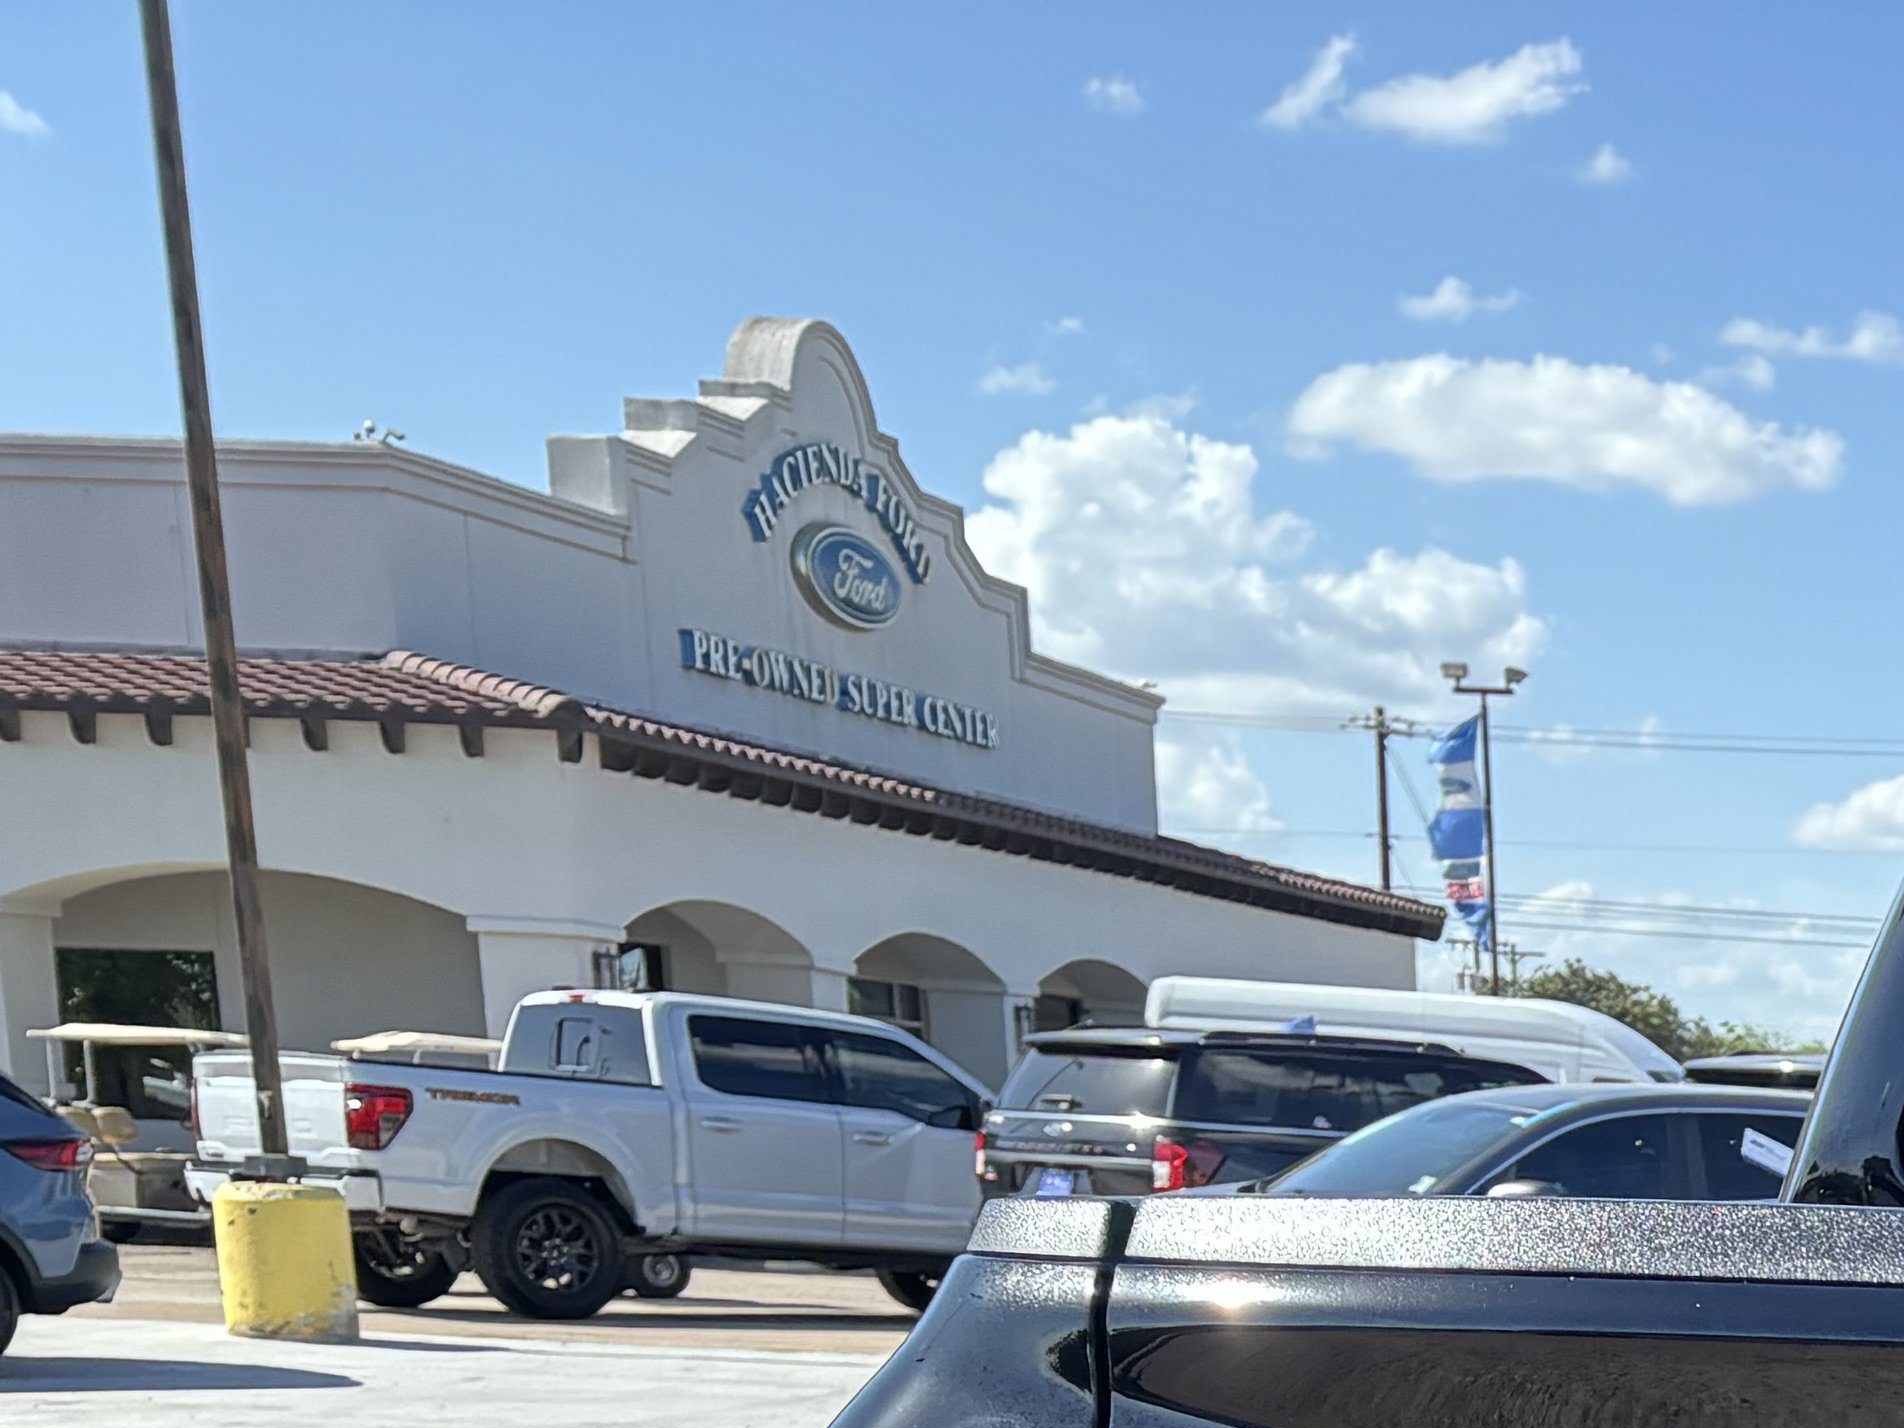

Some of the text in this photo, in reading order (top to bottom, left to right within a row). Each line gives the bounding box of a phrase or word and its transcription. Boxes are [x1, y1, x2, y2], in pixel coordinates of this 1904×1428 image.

[753, 443, 870, 538] HACIENDA
[833, 548, 890, 611] Ford
[693, 629, 1000, 751] PRE-OWNED SUPER CENTER
